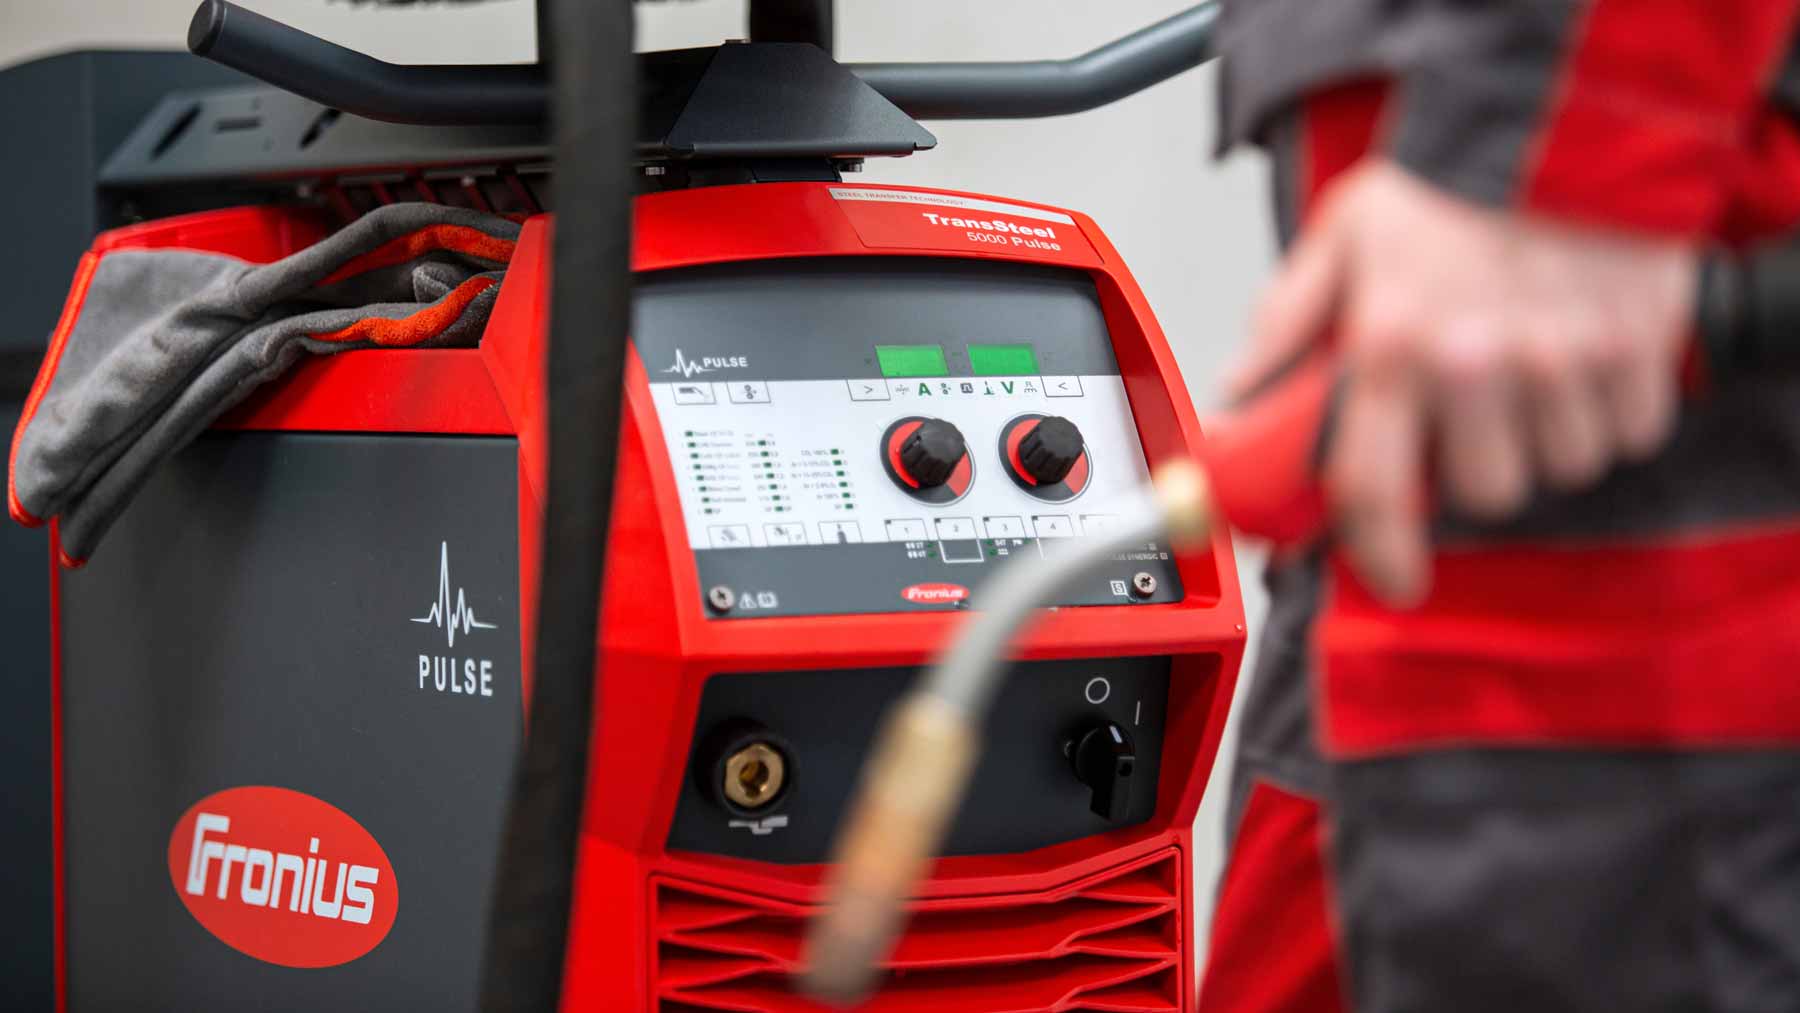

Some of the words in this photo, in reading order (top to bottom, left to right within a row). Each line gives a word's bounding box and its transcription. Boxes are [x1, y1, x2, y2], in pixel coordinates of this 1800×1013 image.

[922, 213, 1056, 239] TransSteel
[967, 231, 1008, 245] 5000
[1011, 236, 1062, 251] Pulse
[703, 357, 748, 368] PULSE
[918, 383, 932, 397] A
[1001, 381, 1014, 394] V
[419, 655, 493, 696] PULSE
[186, 812, 379, 925] Fronius
